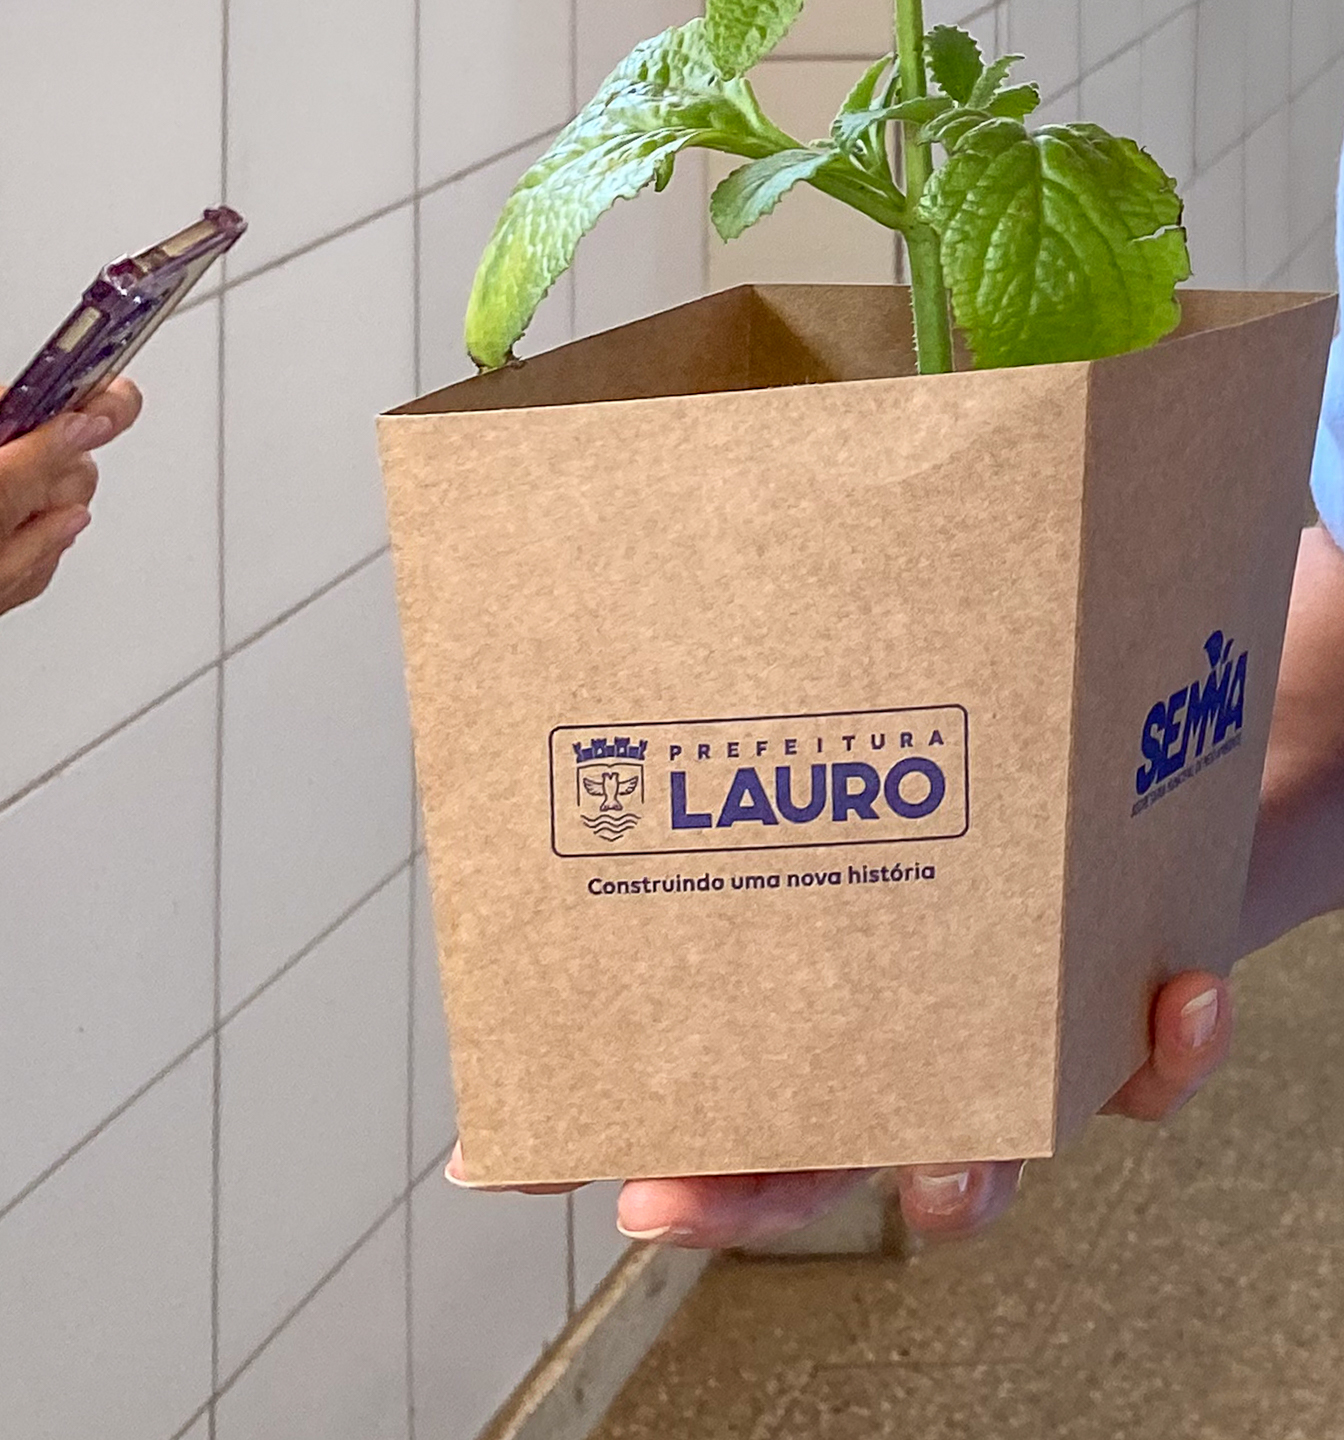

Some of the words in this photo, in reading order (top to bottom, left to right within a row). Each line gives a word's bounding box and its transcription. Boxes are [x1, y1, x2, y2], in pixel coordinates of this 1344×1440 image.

[668, 729, 945, 761] PREFEITURA
[1136, 651, 1249, 796] SEMMA
[671, 756, 946, 831] LAURO
[587, 874, 725, 896] Construindo
[730, 874, 781, 891] uma
[787, 871, 843, 888] nova
[848, 862, 936, 885] história
